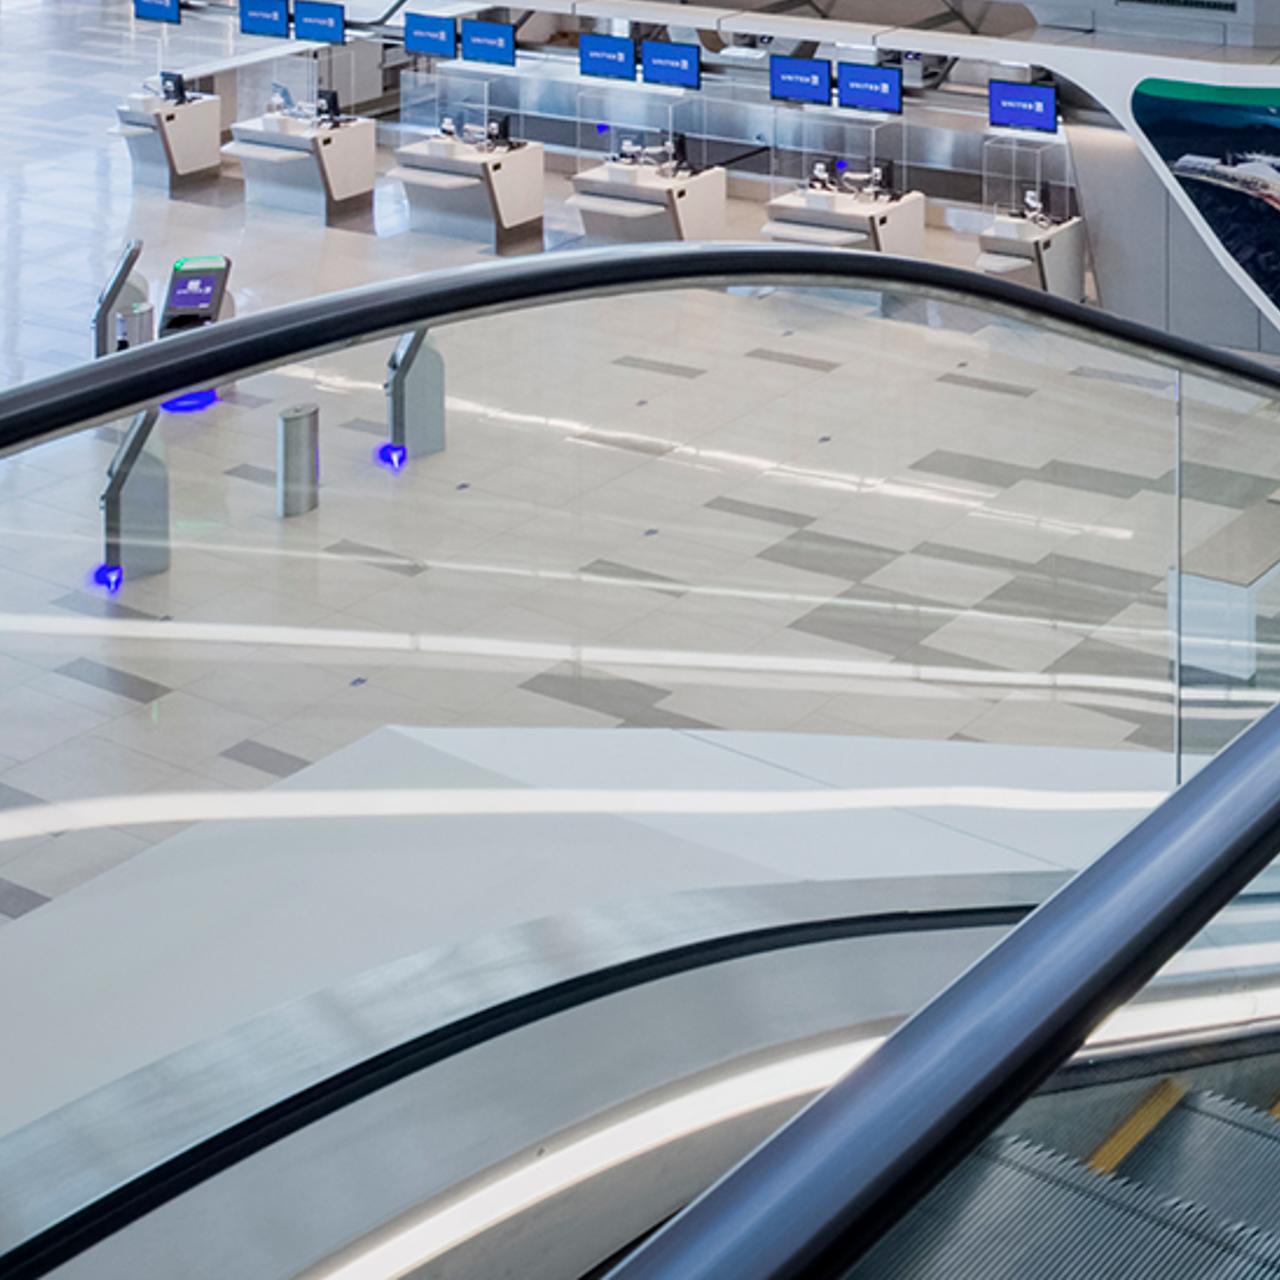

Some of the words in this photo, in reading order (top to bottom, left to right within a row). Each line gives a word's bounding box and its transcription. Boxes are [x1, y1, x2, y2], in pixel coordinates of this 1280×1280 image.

[780, 74, 811, 84] UNITED
[849, 81, 880, 92] UNITED
[1001, 99, 1034, 111] UNITED
